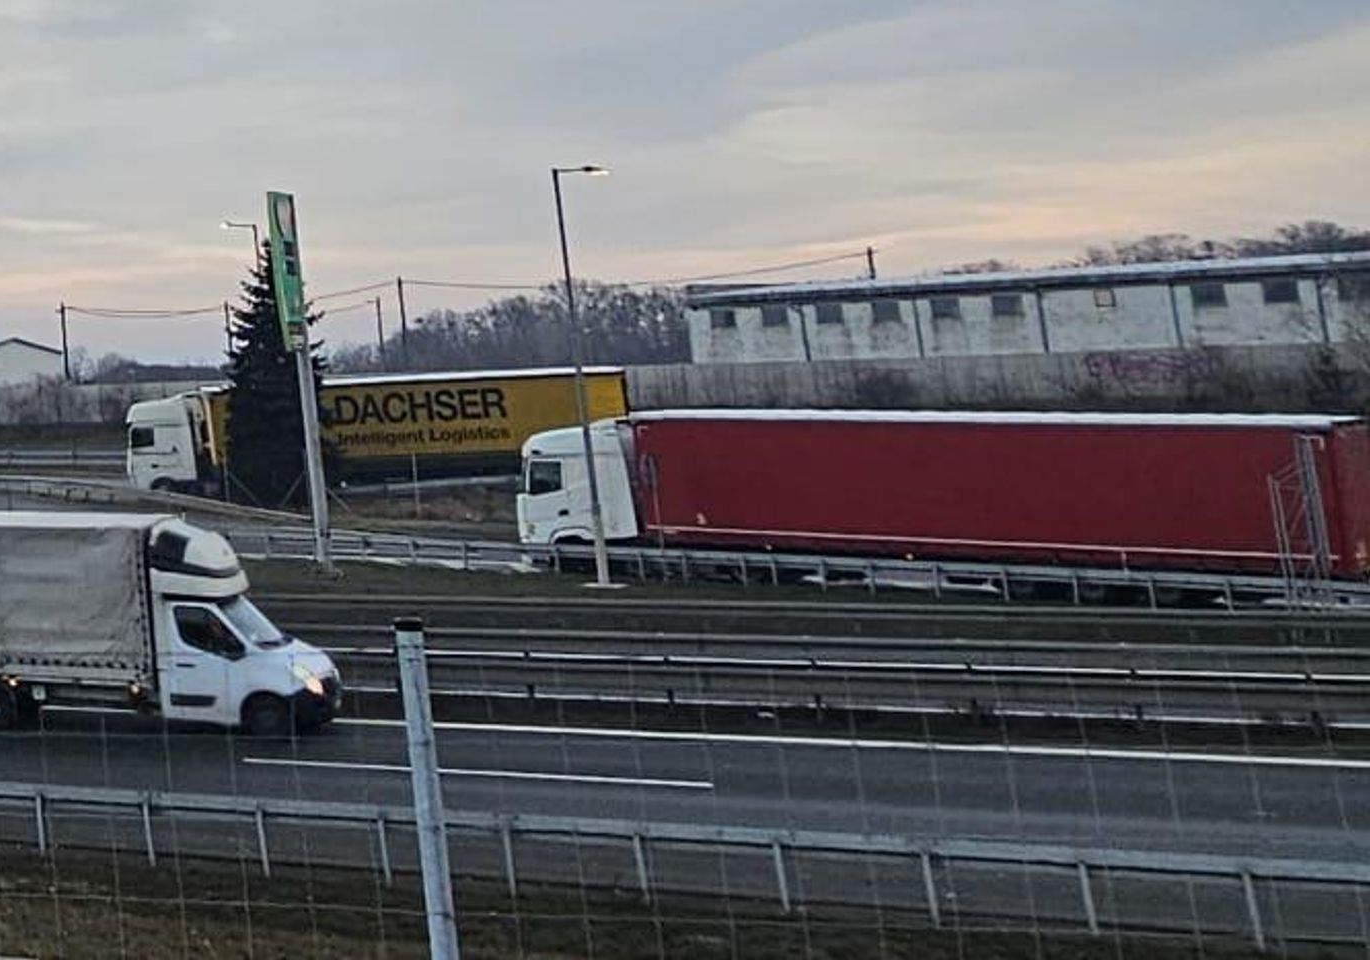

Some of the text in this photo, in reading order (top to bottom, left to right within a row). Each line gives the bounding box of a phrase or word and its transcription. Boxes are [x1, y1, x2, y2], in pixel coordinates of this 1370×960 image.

[333, 389, 507, 425] DACHSER
[338, 425, 512, 446] Intelligent Logistics
